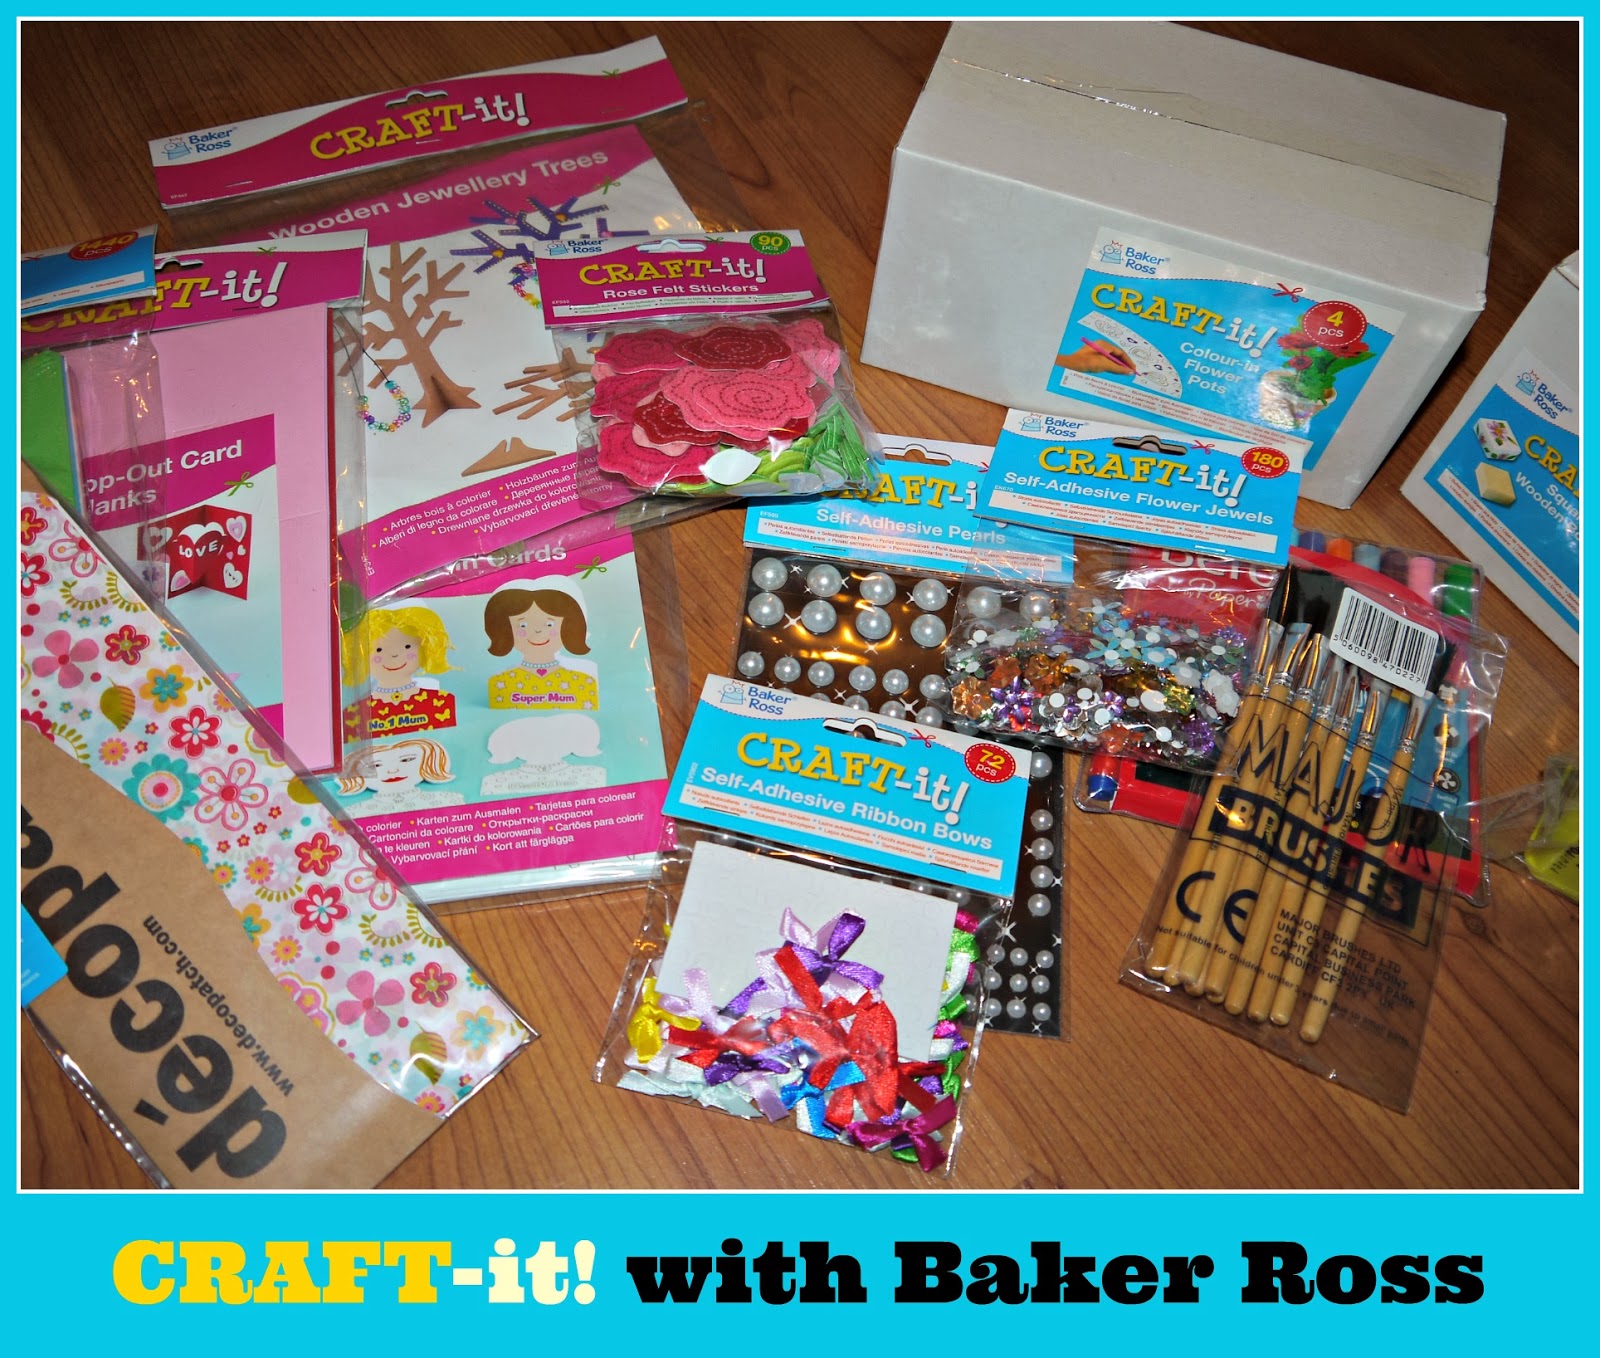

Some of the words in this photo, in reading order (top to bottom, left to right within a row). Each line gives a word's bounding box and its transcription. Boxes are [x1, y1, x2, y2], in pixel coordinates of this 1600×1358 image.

[188, 129, 233, 145] Baker
[310, 92, 531, 161] CRAFT-it!
[195, 140, 232, 153] Ross
[268, 201, 391, 240] Wooden
[396, 169, 529, 210] Jewellery
[531, 151, 609, 178] Trees
[79, 234, 136, 252] 1440
[84, 246, 113, 257] pcs
[567, 238, 604, 248] Baker
[573, 245, 603, 254] Ross
[757, 234, 783, 247] 90
[1125, 247, 1165, 266] Baker
[1125, 260, 1156, 275] Ross
[579, 257, 768, 285] CRAFT-it!
[603, 286, 648, 299] Rose
[653, 284, 685, 295] Felt
[689, 283, 759, 294] Stickers
[1090, 283, 1278, 359] CRAFT-it!
[1326, 310, 1344, 328] 4
[1317, 325, 1344, 340] pcs
[1179, 341, 1261, 374] Colour-in
[1183, 359, 1244, 384] Flower
[1187, 374, 1228, 395] Pots
[1533, 394, 1559, 420] Ross
[1537, 383, 1569, 414] Baker
[1045, 416, 1084, 430] Baker
[1046, 427, 1077, 438] Ross
[86, 457, 173, 494] op-Out
[180, 439, 243, 470] Card
[1251, 450, 1285, 469] 180
[1251, 463, 1272, 474] pcs
[1524, 434, 1579, 499] CRA
[505, 468, 559, 490] Holzbäume
[510, 474, 571, 500] Деревянные
[1038, 446, 1248, 508] CRAFT-it!
[90, 489, 157, 516] lanks
[390, 512, 422, 531] Arbres
[424, 506, 446, 518] bois
[447, 502, 454, 511] à
[455, 490, 492, 507] colorier
[1003, 471, 1131, 502] Self-Adhesive
[1136, 492, 1202, 514] Flower
[1205, 503, 1274, 525] Jewels
[1515, 471, 1565, 526] Wooden
[407, 525, 417, 534] di
[417, 517, 445, 531] legno
[446, 514, 459, 522] da
[460, 499, 498, 518] colorare
[438, 514, 491, 534] Drewniane
[492, 498, 533, 517] drzewka
[534, 493, 547, 502] do
[479, 505, 540, 534] Vybarvovací
[815, 508, 943, 537] Self-Adhesive
[948, 524, 1006, 546] Pearls
[511, 692, 546, 704] Super
[548, 693, 575, 703] Mum
[748, 686, 792, 705] Baker
[748, 698, 783, 715] Ross
[368, 717, 395, 731] No.1
[397, 714, 427, 727] Mum
[976, 762, 998, 777] pcs
[978, 748, 1006, 770] 72
[737, 732, 970, 826] CRAFT-it!
[1237, 713, 1432, 875] MAJOR
[366, 821, 402, 833] colorier
[416, 815, 449, 827] Karten
[451, 813, 472, 821] zum
[474, 806, 521, 819] Ausmalen
[535, 799, 573, 812] Tarjetas
[575, 797, 596, 808] para
[598, 791, 637, 804] colorear
[488, 809, 594, 829] Открытки-раскраски
[701, 767, 846, 814] Self-Adhesive
[851, 801, 927, 835] Ribbon
[932, 821, 993, 851] Bows
[368, 829, 418, 844] Cartoncini
[420, 828, 433, 837] da
[434, 824, 474, 836] colorare
[384, 844, 394, 853] te
[396, 841, 430, 852] kleuren
[444, 834, 471, 846] Kartki
[473, 833, 486, 842] do
[487, 826, 542, 841] kolorowania
[555, 817, 592, 832] Cartões
[594, 817, 614, 828] para
[616, 812, 645, 824] colorir
[391, 848, 450, 866] Vybarvovací
[453, 845, 478, 858] přání
[492, 841, 513, 852] Kort
[515, 840, 527, 849] att
[530, 833, 575, 848] färglägga
[1280, 908, 1320, 934] MAJOR
[1323, 930, 1377, 962] BRUSHES
[1379, 957, 1402, 973] LTD
[1156, 925, 1173, 937] Not
[1175, 929, 1212, 949] suitable
[1214, 943, 1227, 955] for
[1228, 952, 1265, 976] children
[1267, 970, 1295, 988] under
[1270, 945, 1320, 975] CARDIFF
[1321, 971, 1343, 989] CF3
[1273, 933, 1320, 963] CAPITAL
[1325, 958, 1382, 991] BUSINESS
[1277, 921, 1304, 938] UNIT
[1324, 942, 1370, 973] CAPITAL
[1374, 967, 1409, 989] POINT
[142, 914, 294, 1097] www.decopatch.com
